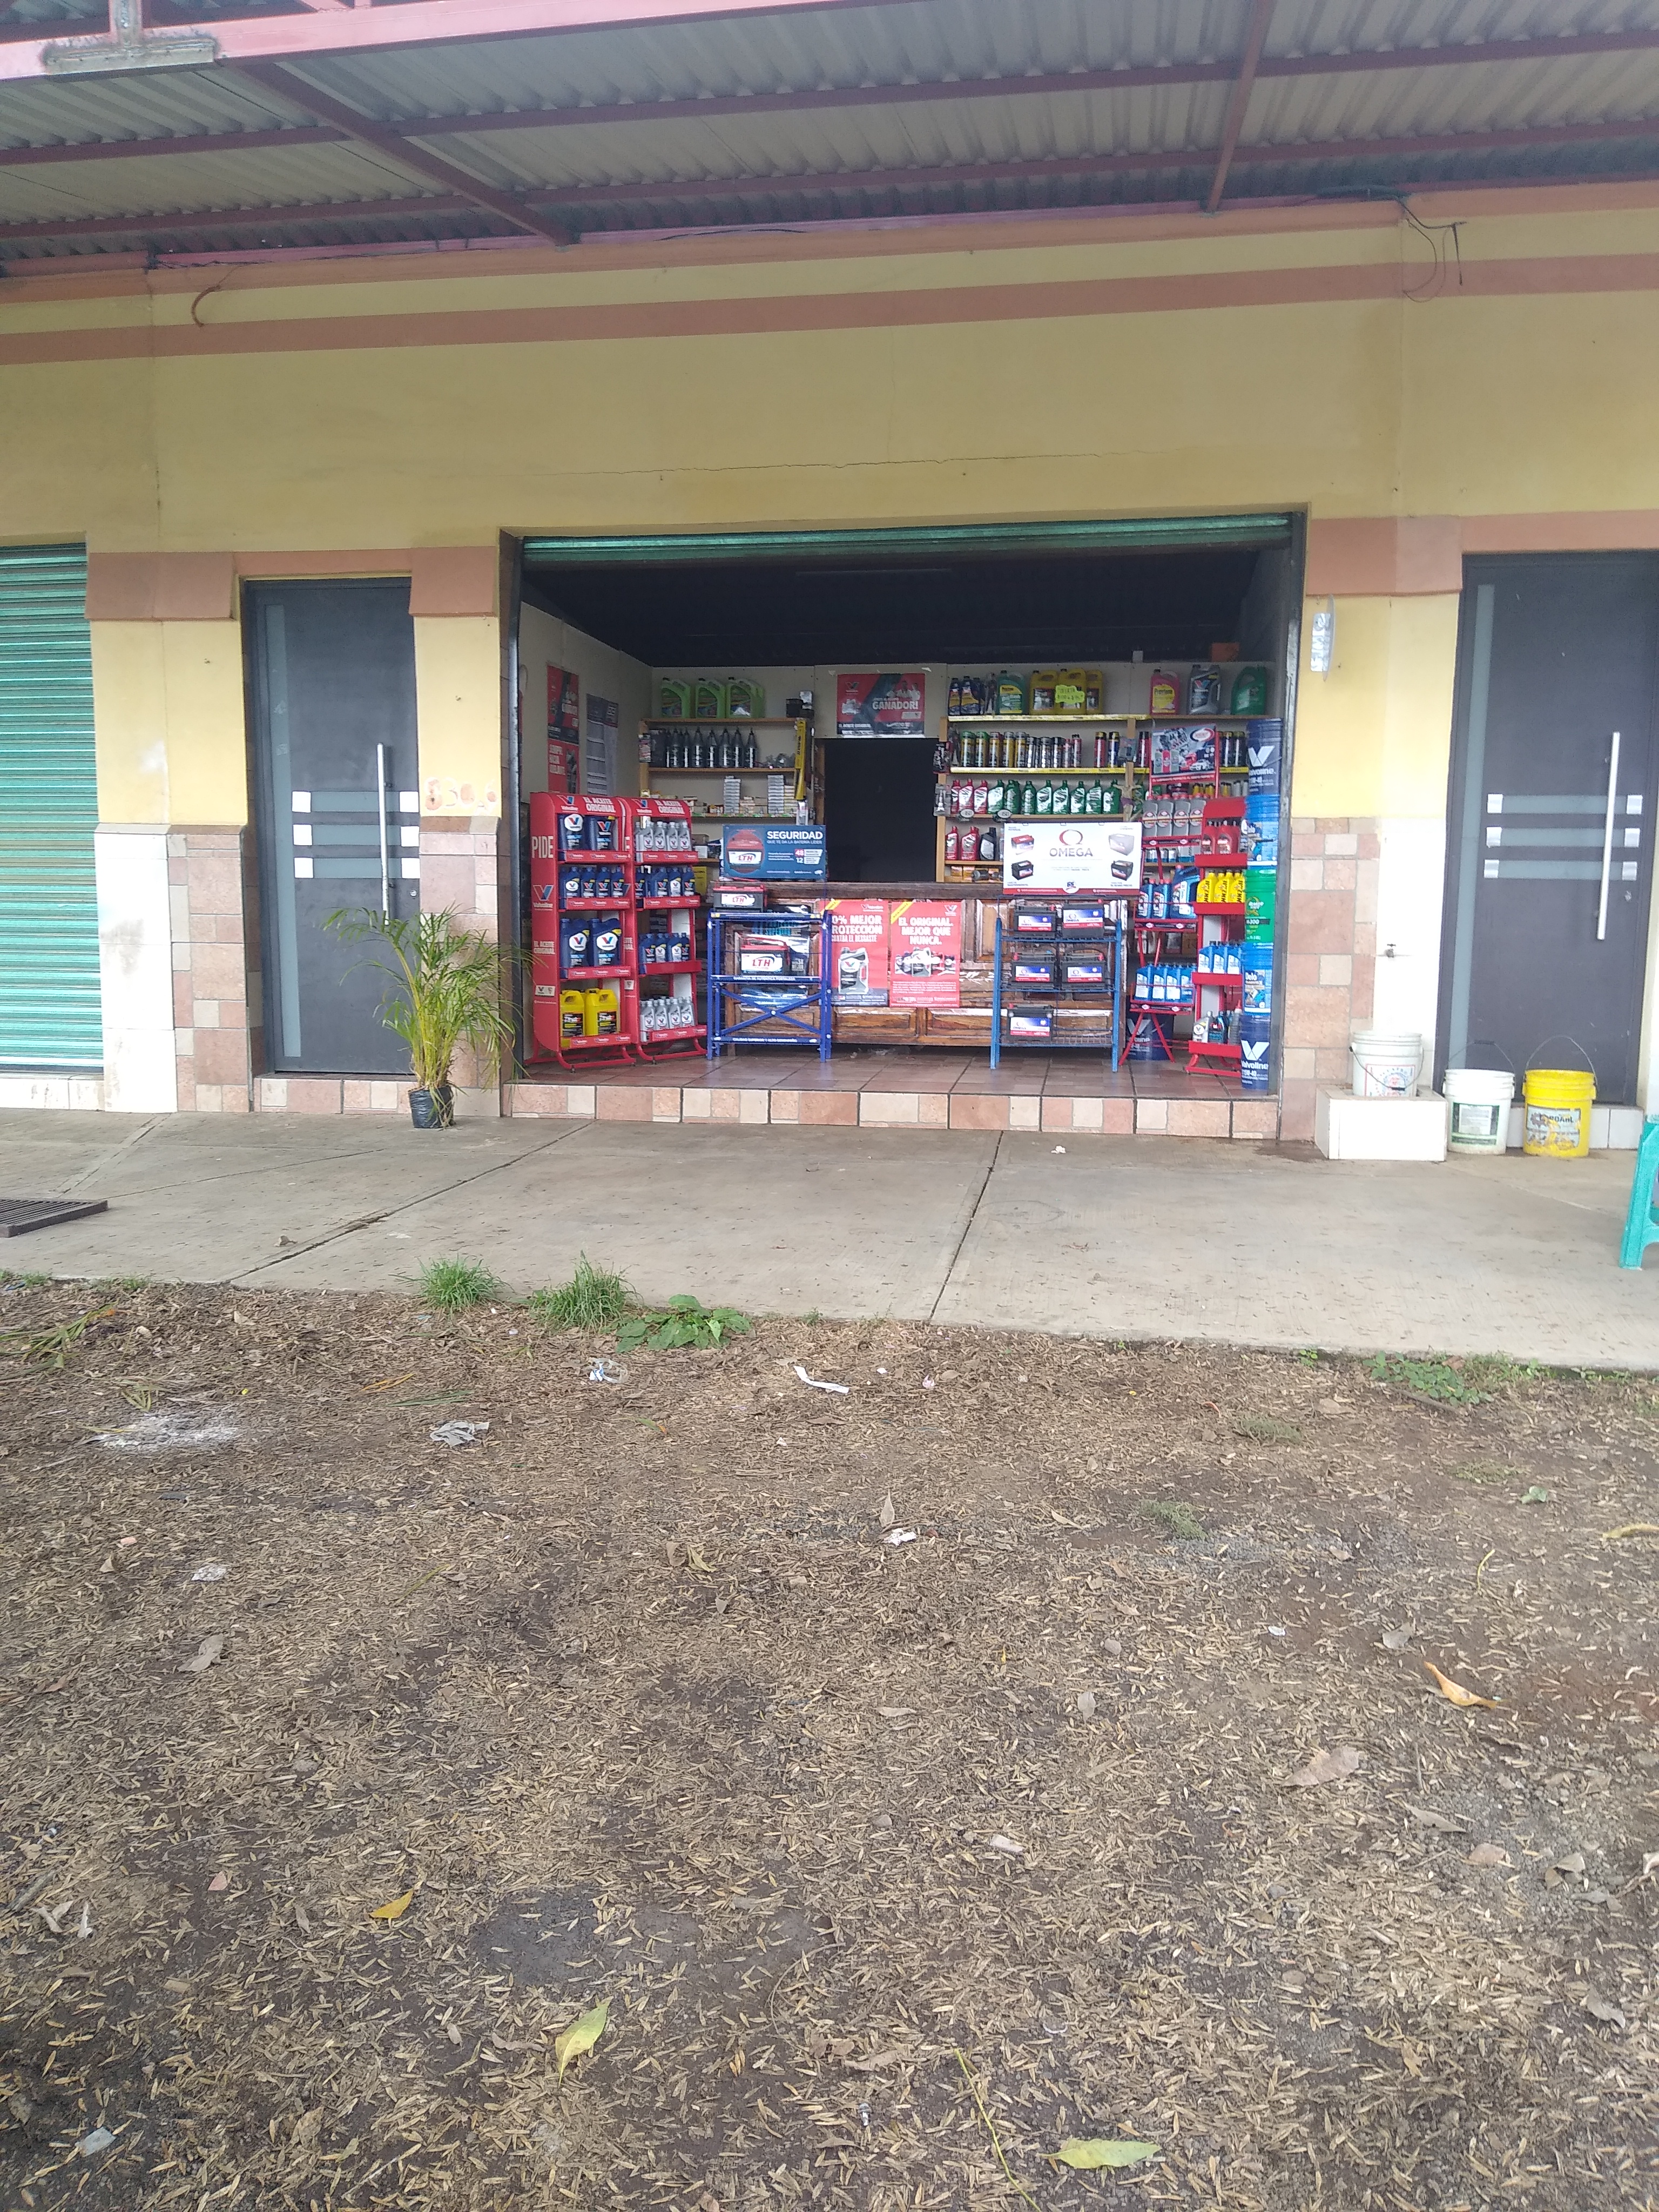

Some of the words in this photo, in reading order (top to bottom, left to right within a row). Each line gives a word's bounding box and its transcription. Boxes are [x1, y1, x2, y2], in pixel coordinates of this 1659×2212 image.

[585, 803, 616, 813] ORIGINAL
[658, 806, 685, 814] ORIGINAL
[767, 831, 824, 840] SEGURIDAD
[531, 835, 554, 859] PIDE
[1049, 847, 1093, 857] OMEGA
[849, 914, 882, 925] MEJOR
[898, 917, 908, 926] EL
[909, 917, 954, 927] ORIGINAL.
[832, 925, 883, 935] ROTECCION
[901, 926, 931, 936] MEJOR
[932, 926, 951, 936] QUE
[909, 935, 942, 945] NUNCA.
[752, 959, 771, 967] LTH
[1245, 972, 1257, 981] Delo
